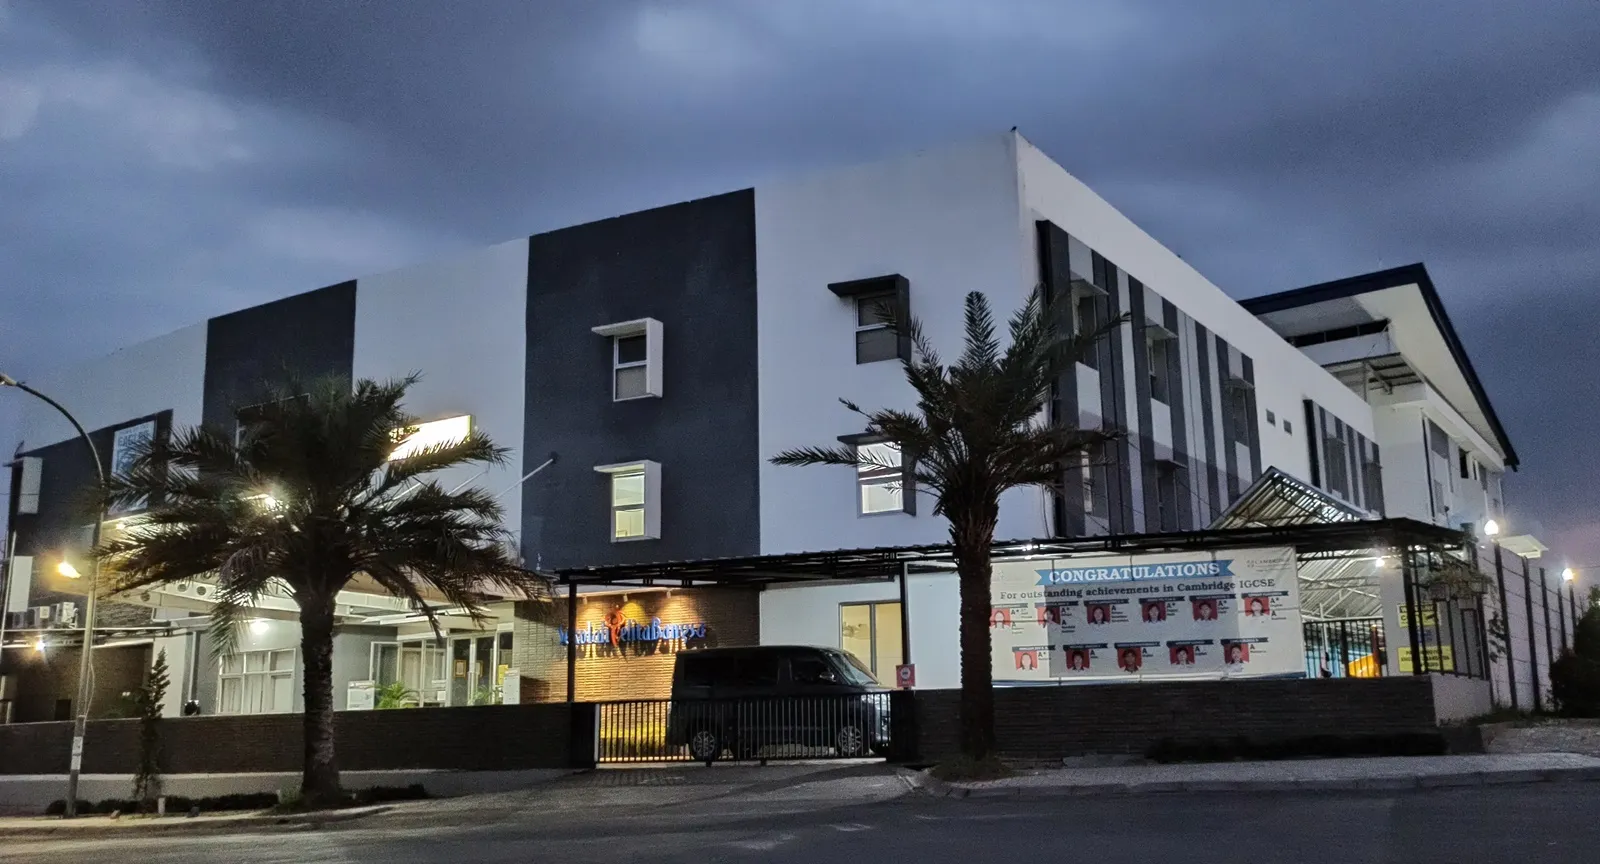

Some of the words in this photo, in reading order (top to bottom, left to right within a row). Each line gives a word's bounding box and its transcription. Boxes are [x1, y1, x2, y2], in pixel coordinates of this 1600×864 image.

[1049, 562, 1220, 582] CONGRATULATIONS
[1000, 591, 1018, 599] For
[1021, 587, 1082, 599] outstanding
[1086, 584, 1159, 596] achievements
[1163, 582, 1174, 592] in
[1177, 580, 1236, 592] Cambridge
[1239, 578, 1276, 589] IGCSE
